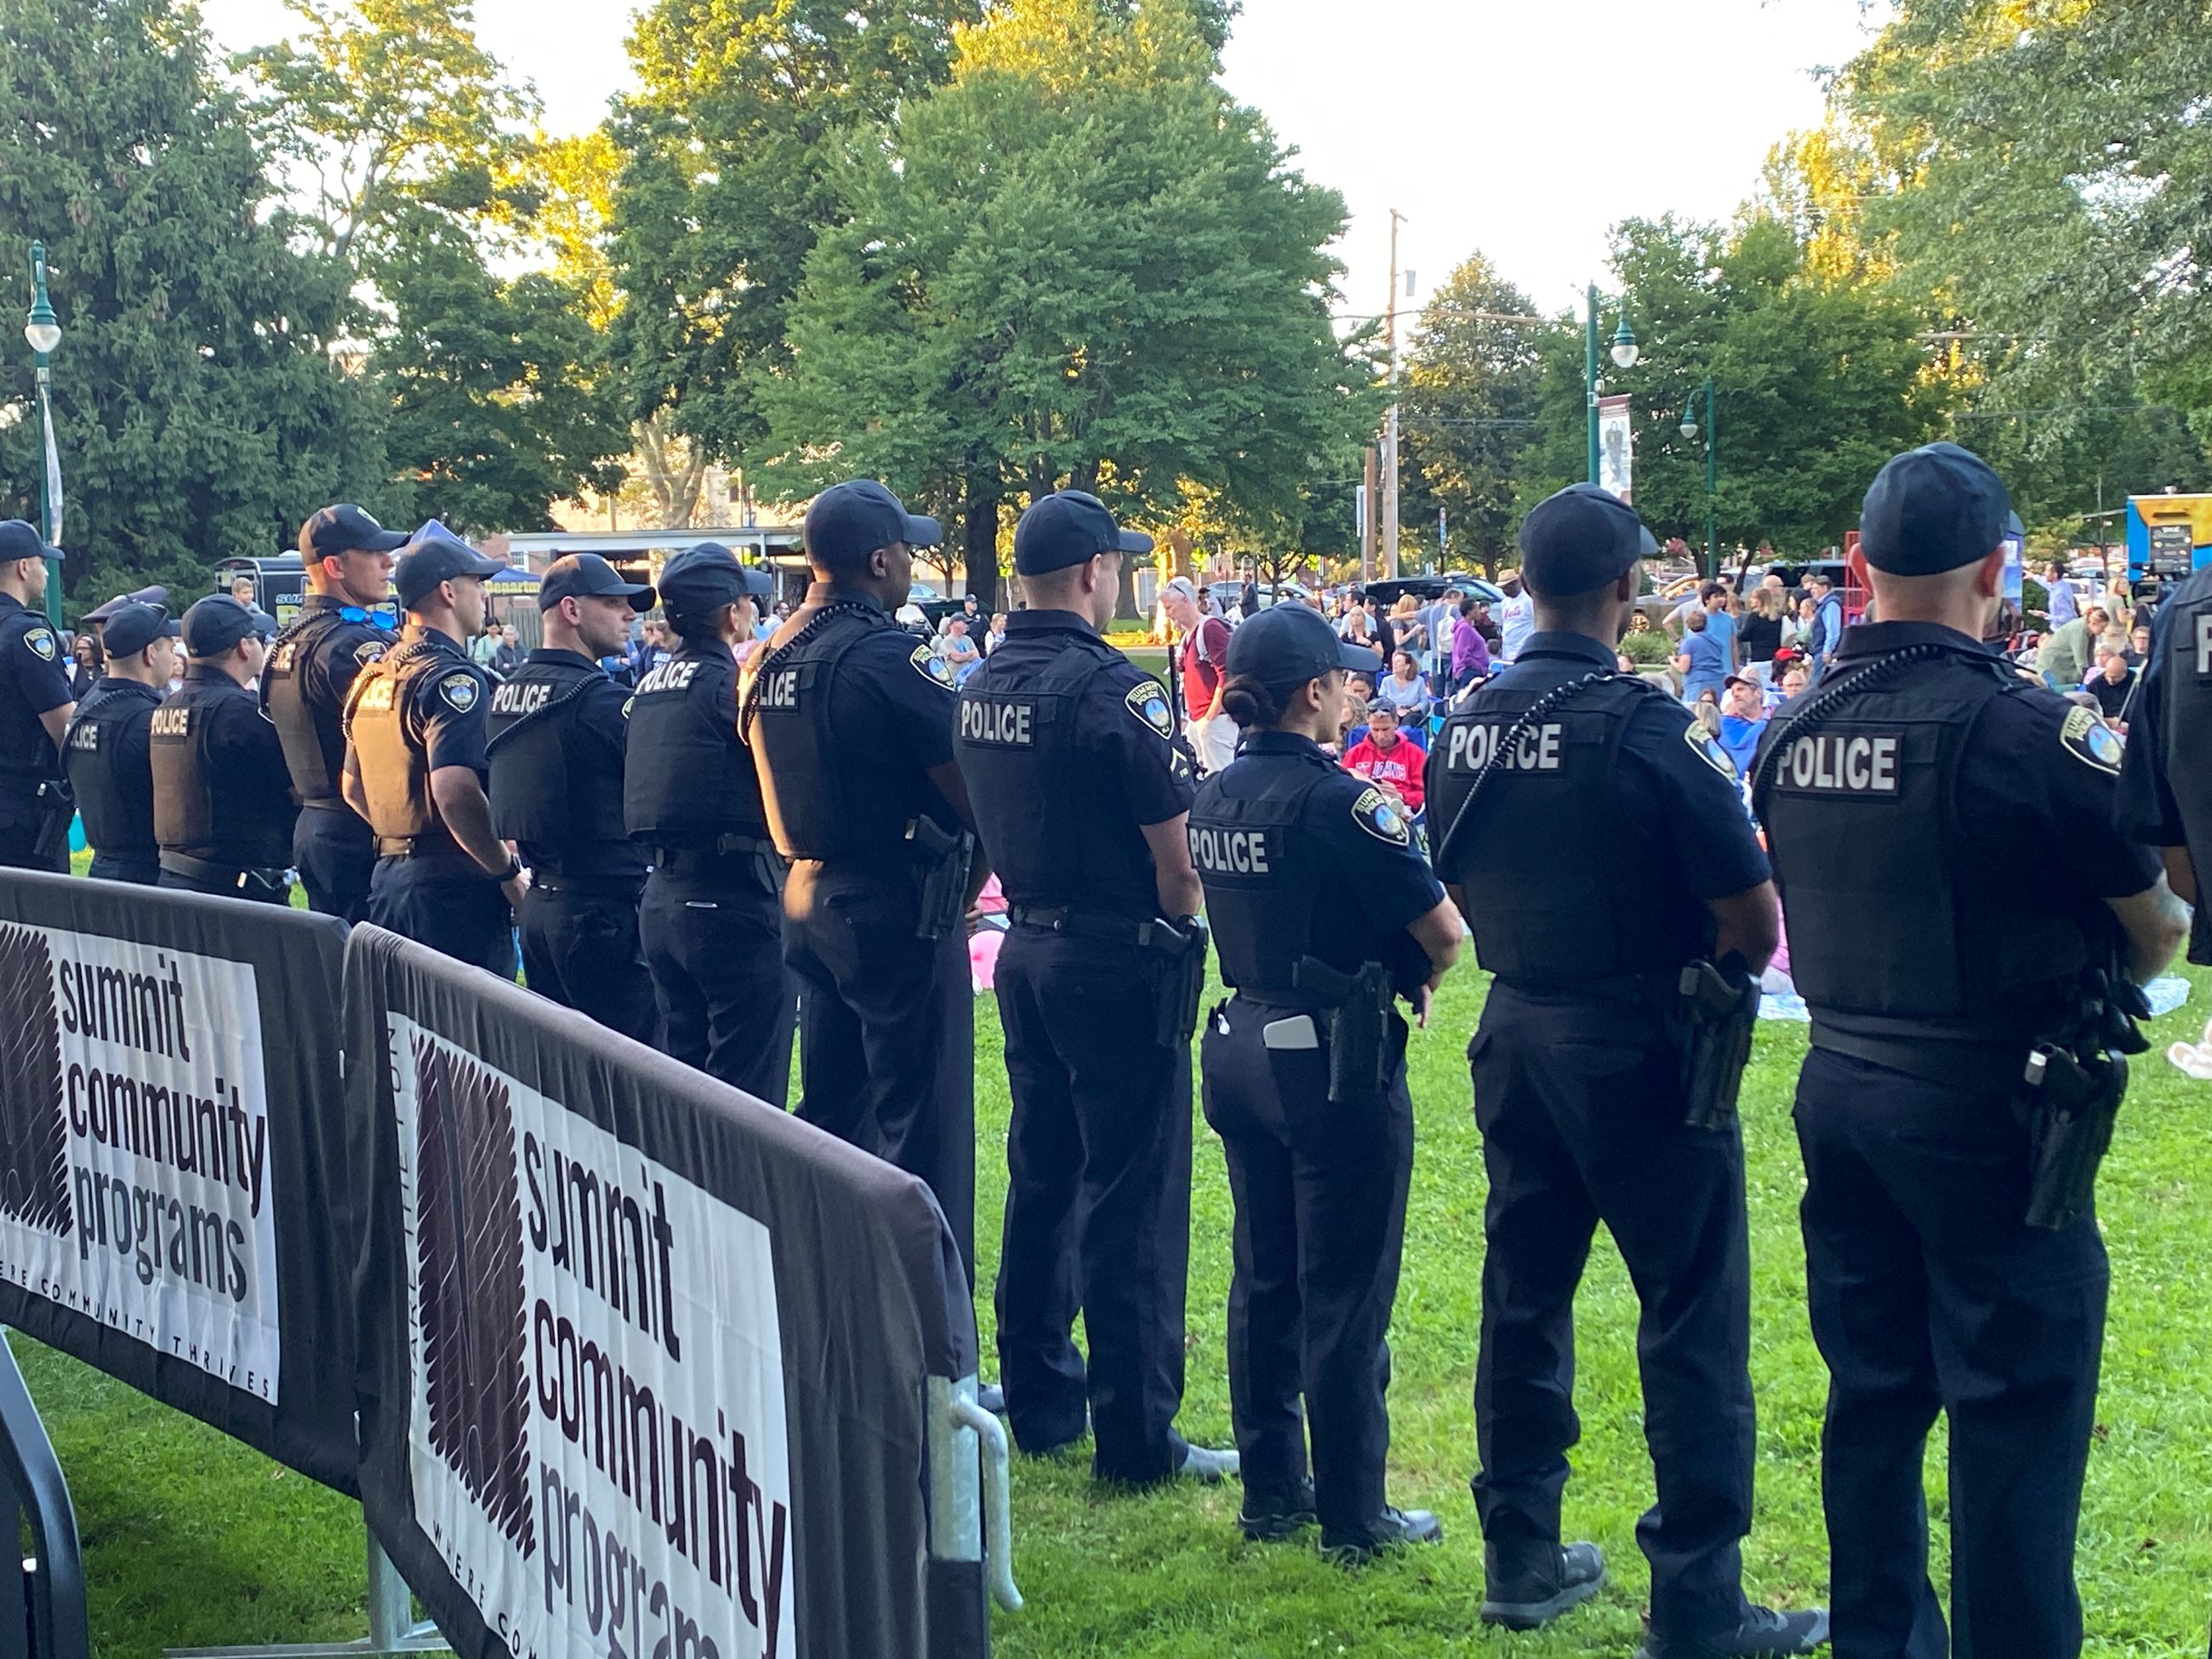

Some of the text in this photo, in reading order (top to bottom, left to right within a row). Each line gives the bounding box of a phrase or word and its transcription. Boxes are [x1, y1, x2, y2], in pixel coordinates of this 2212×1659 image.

[492, 684, 551, 713] POLICE
[636, 661, 699, 694] POLICE
[759, 670, 797, 707] LICE
[65, 723, 98, 749] LICE
[151, 709, 189, 734] POLICE
[961, 700, 1031, 743] POLICE
[1775, 736, 1896, 790] POLICE
[1189, 828, 1269, 873] POLICE
[60, 954, 190, 1063] summit
[68, 1063, 265, 1219] community
[74, 1166, 248, 1303] programs
[524, 1131, 681, 1363] summit
[41, 1279, 156, 1342] COMMUNITY
[173, 1336, 269, 1398] THRIVES
[534, 1298, 787, 1659] community
[433, 1519, 485, 1610] WHERE
